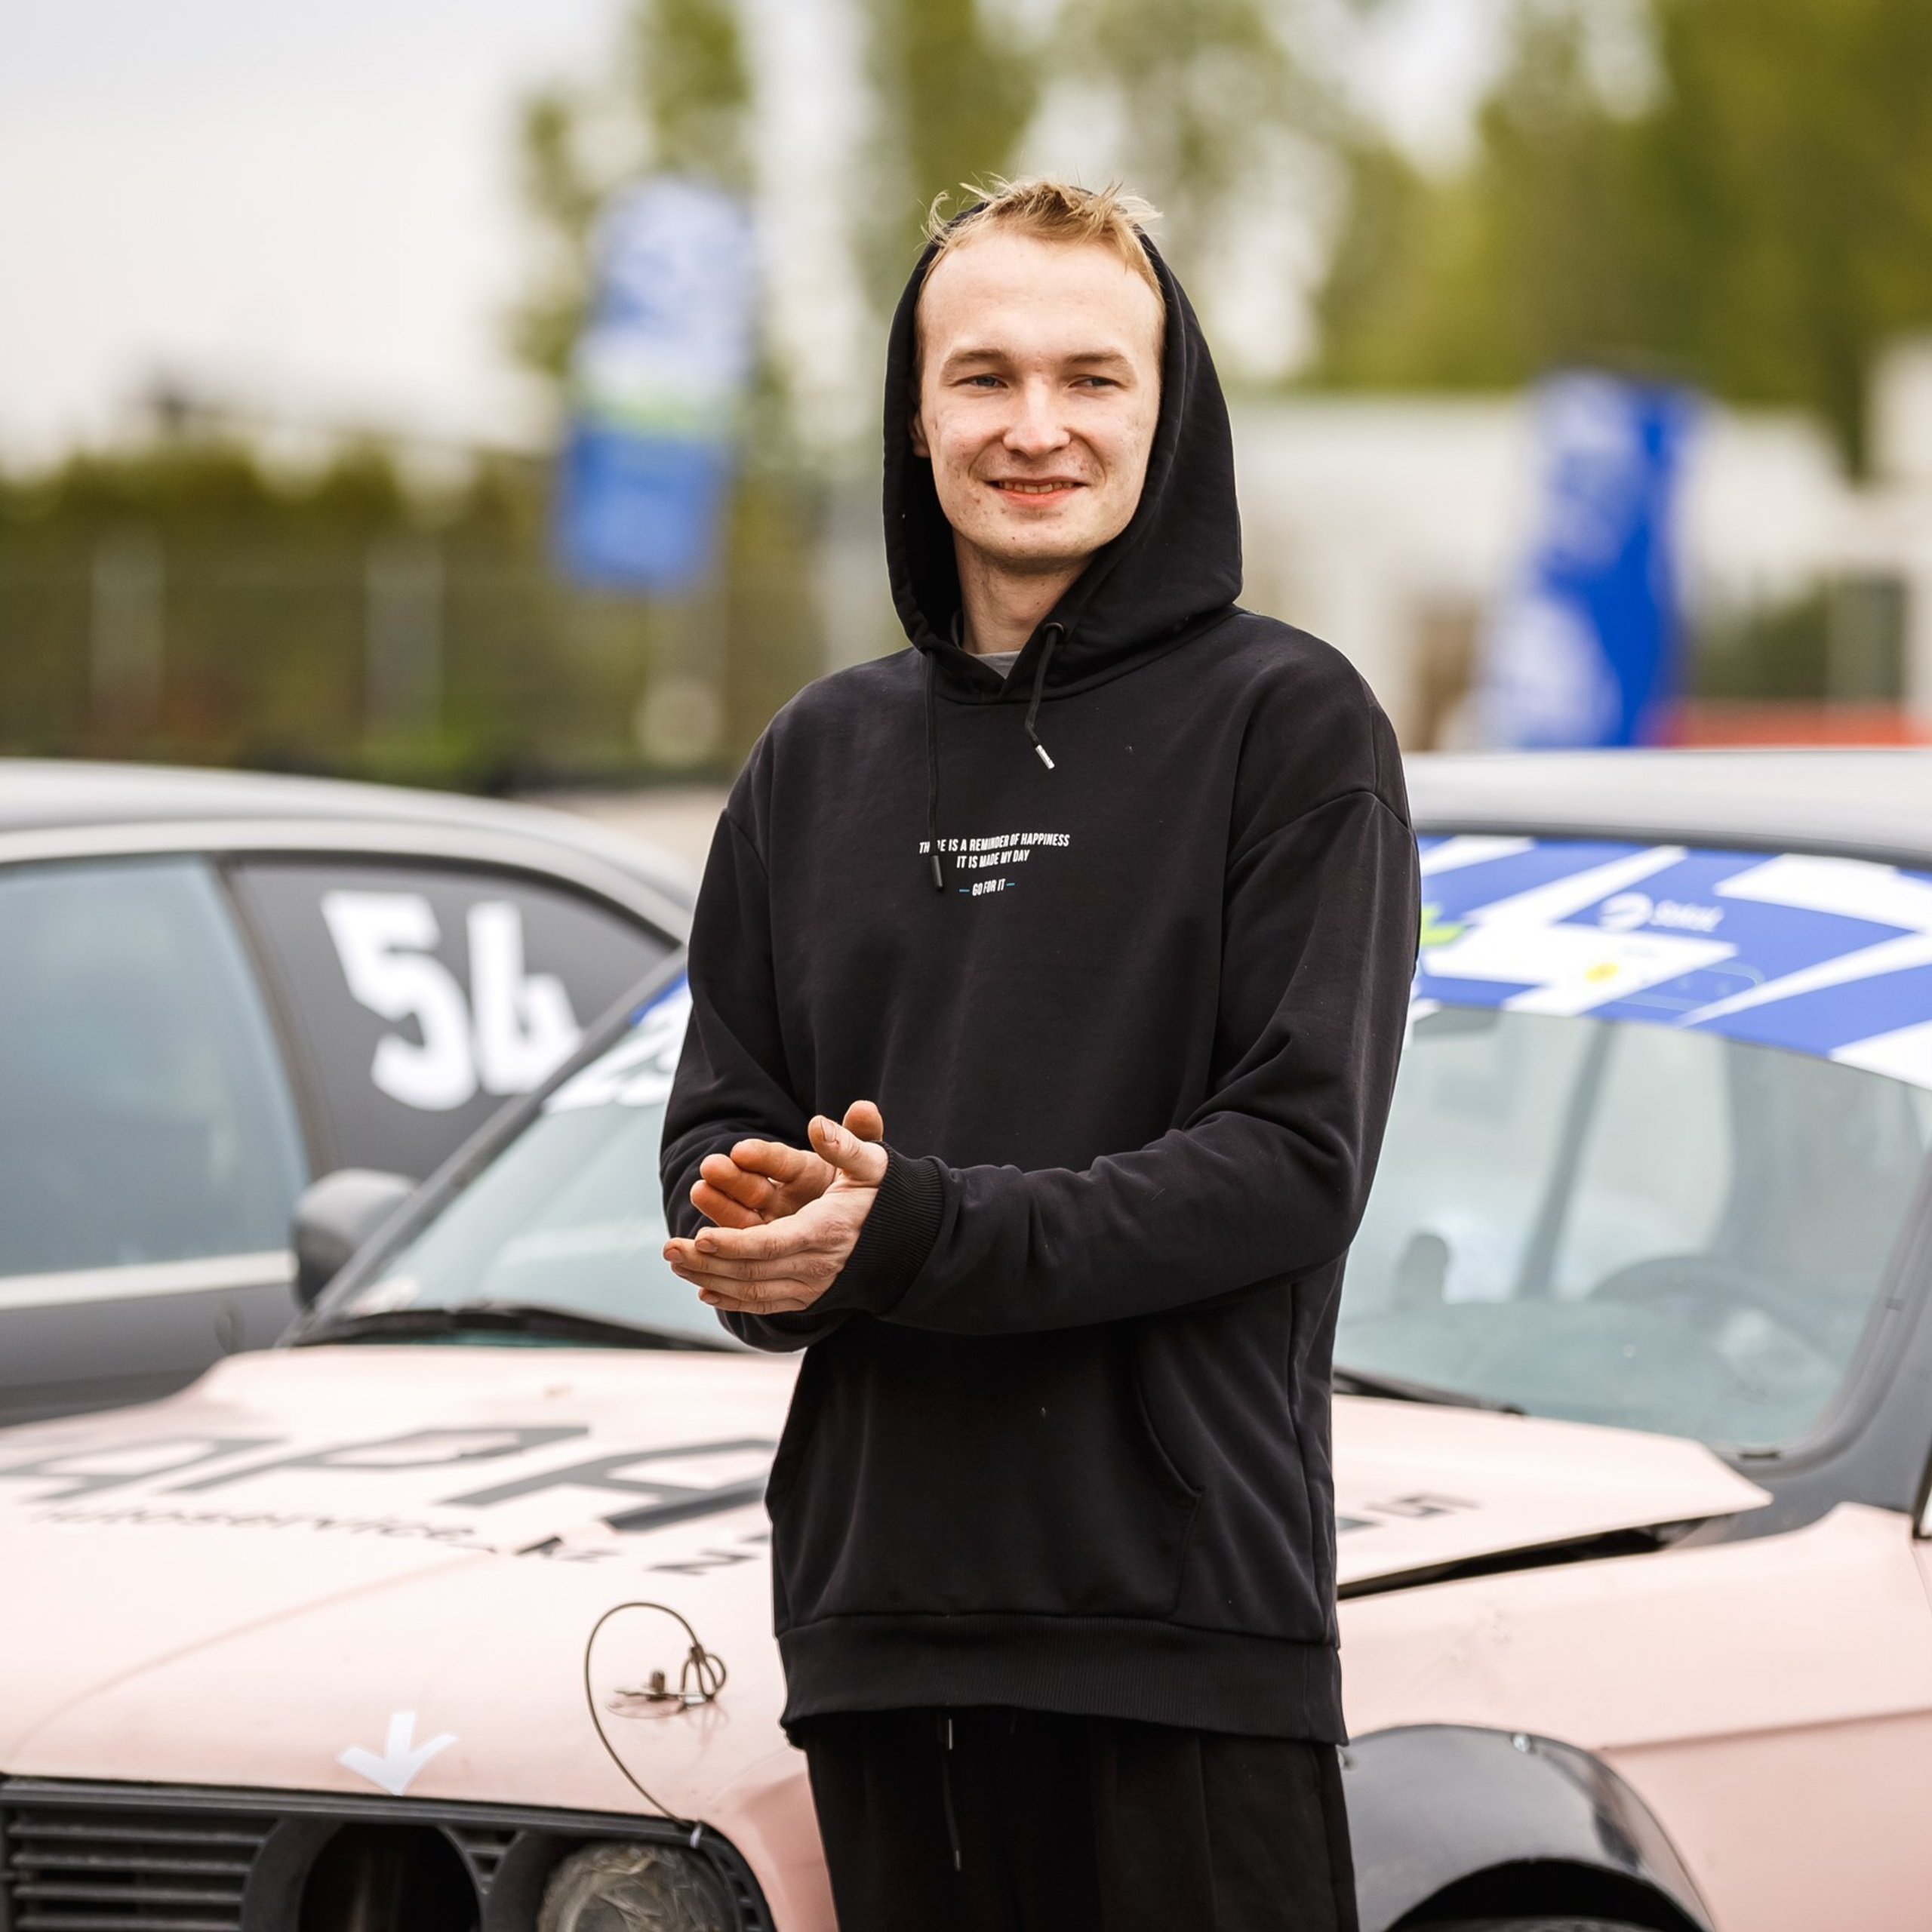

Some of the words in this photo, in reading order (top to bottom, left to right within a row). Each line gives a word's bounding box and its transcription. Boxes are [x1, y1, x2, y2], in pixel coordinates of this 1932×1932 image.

[919, 839, 946, 854] THE
[948, 838, 958, 851] IS
[960, 838, 968, 851] A
[969, 835, 1010, 851] REMINDER
[1010, 833, 1020, 846] OF
[1020, 833, 1070, 847] HAPPINESS
[956, 856, 967, 869] IT
[968, 856, 979, 869] IS
[979, 852, 1001, 868] MADE
[1000, 850, 1013, 864] MY
[1012, 849, 1030, 863] DAY
[972, 883, 983, 896] GO
[983, 879, 997, 894] FOR
[997, 878, 1006, 891] IT
